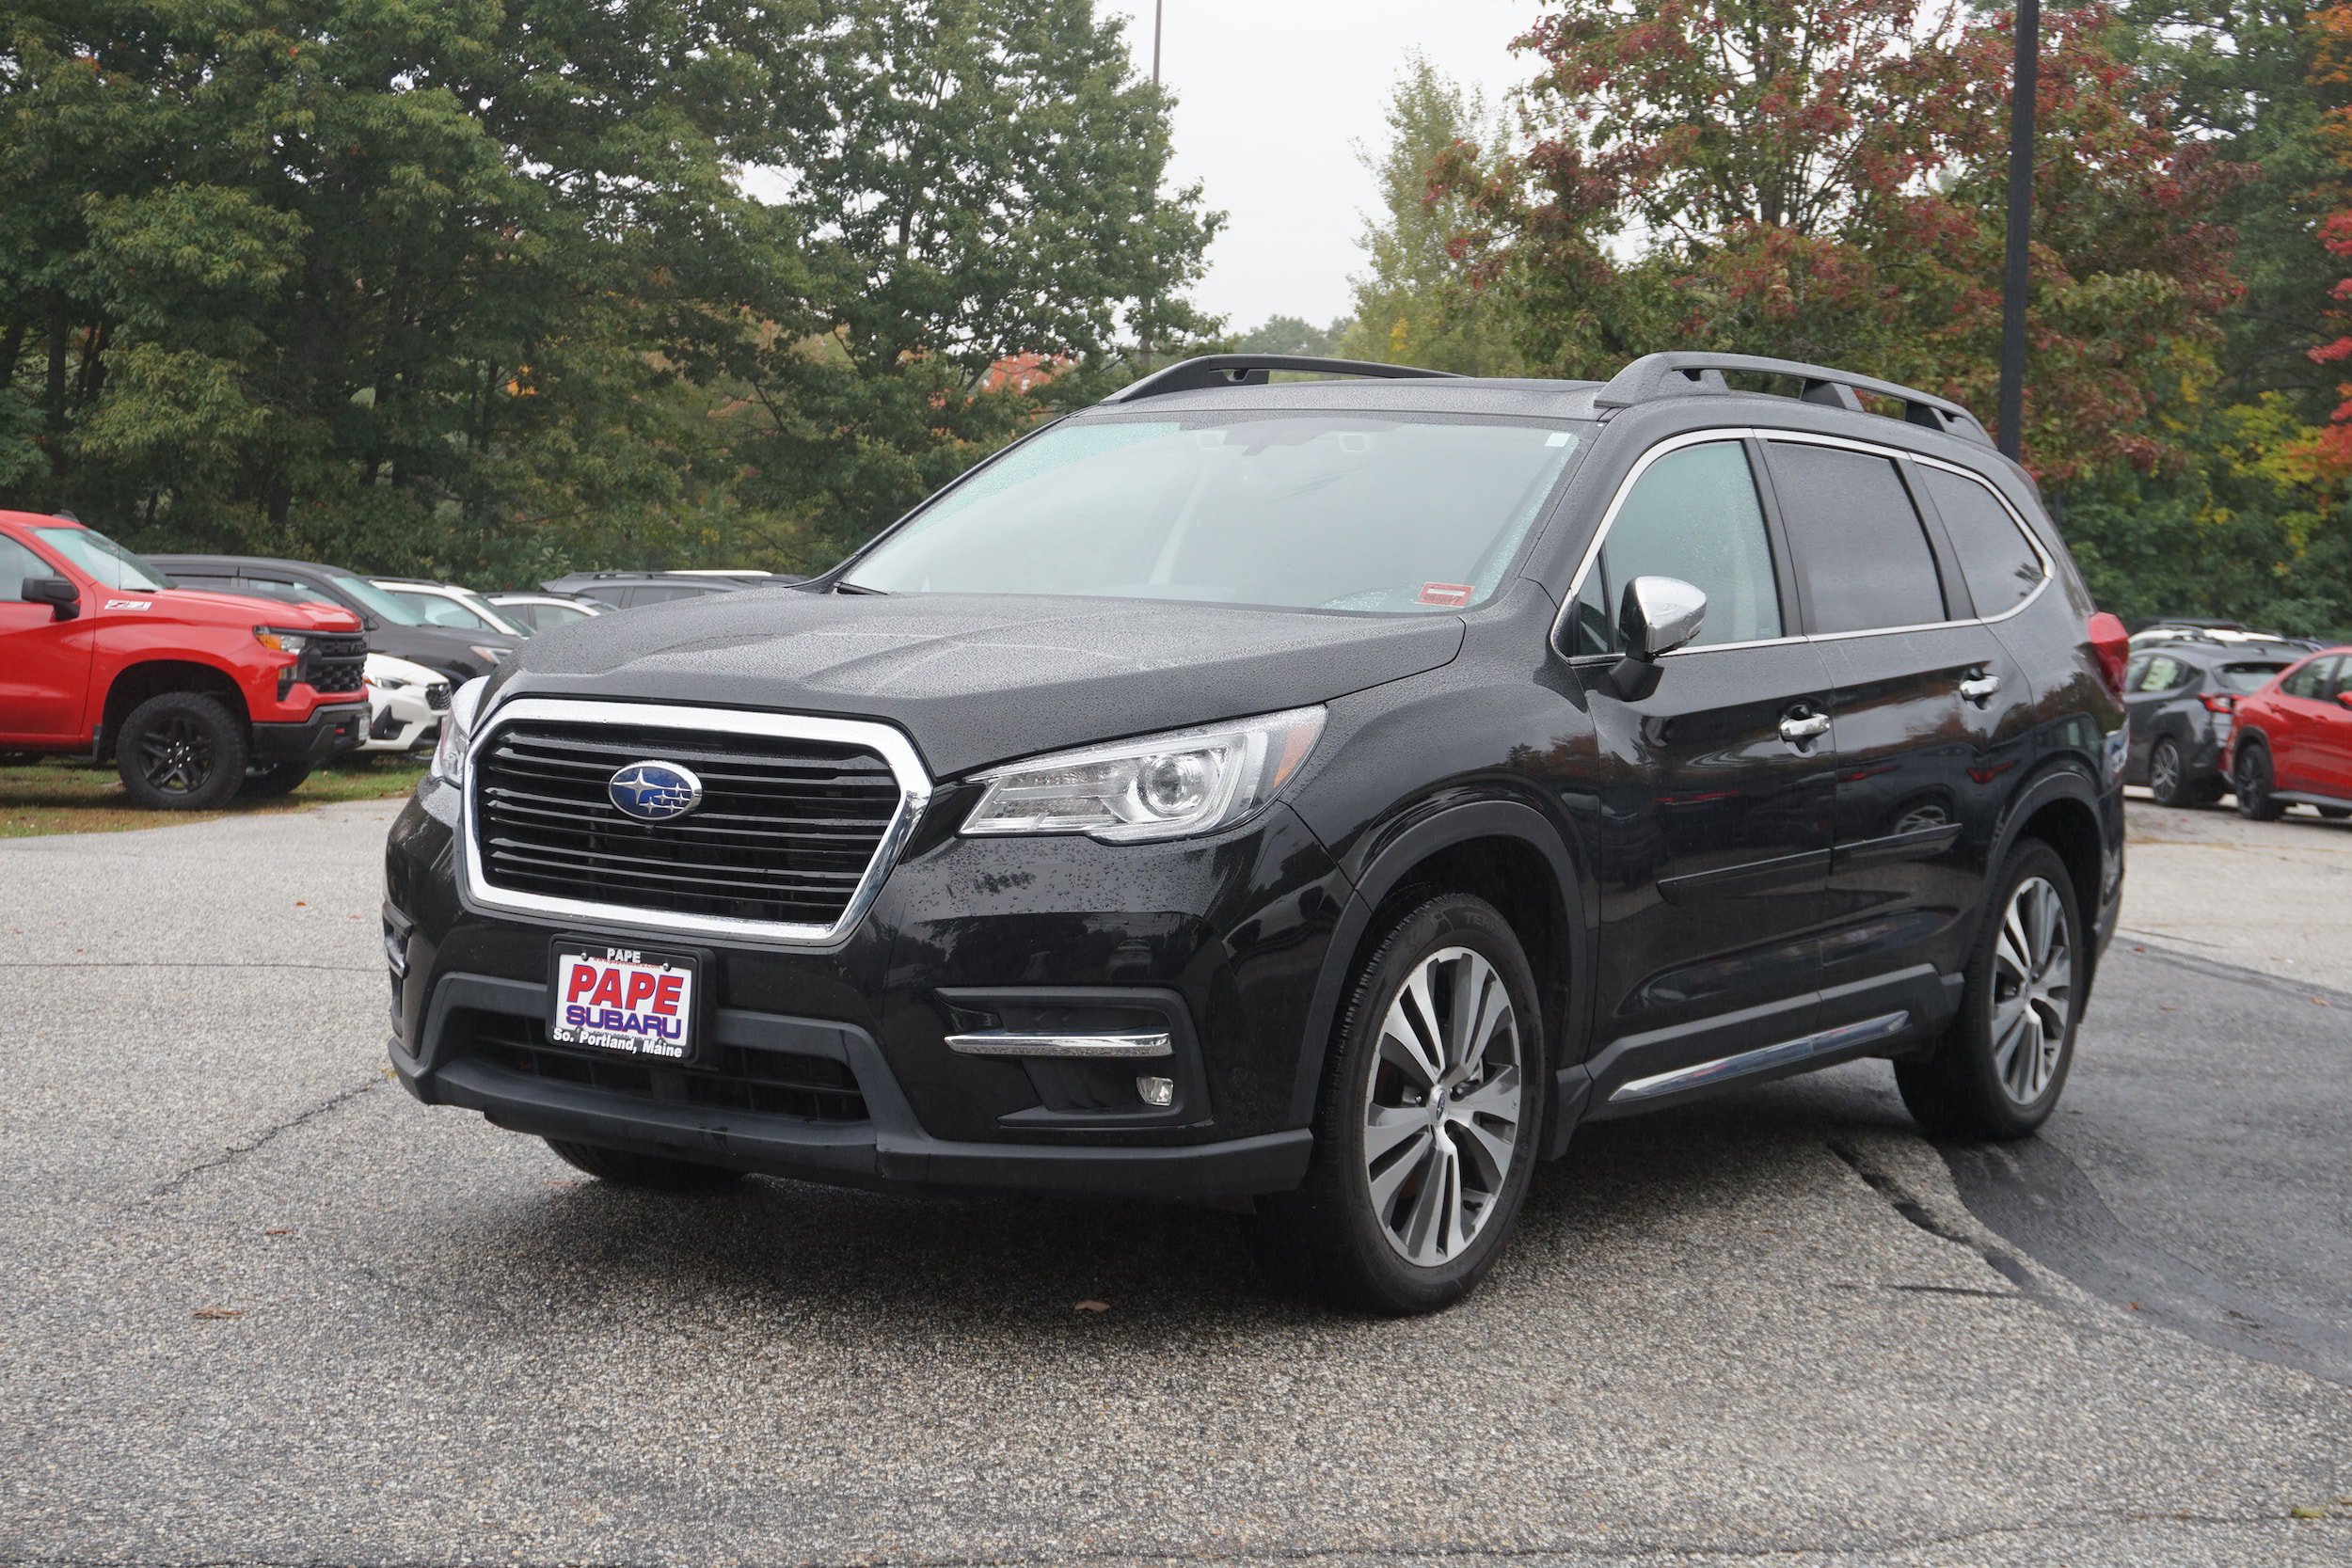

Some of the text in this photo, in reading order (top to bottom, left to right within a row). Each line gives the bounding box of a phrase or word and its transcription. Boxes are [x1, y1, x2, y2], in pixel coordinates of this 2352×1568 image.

[607, 948, 642, 963] PAPE
[566, 964, 684, 1017] PAPE
[566, 1005, 682, 1040] SUBARU
[552, 1027, 683, 1058] So. Portland, Maine
